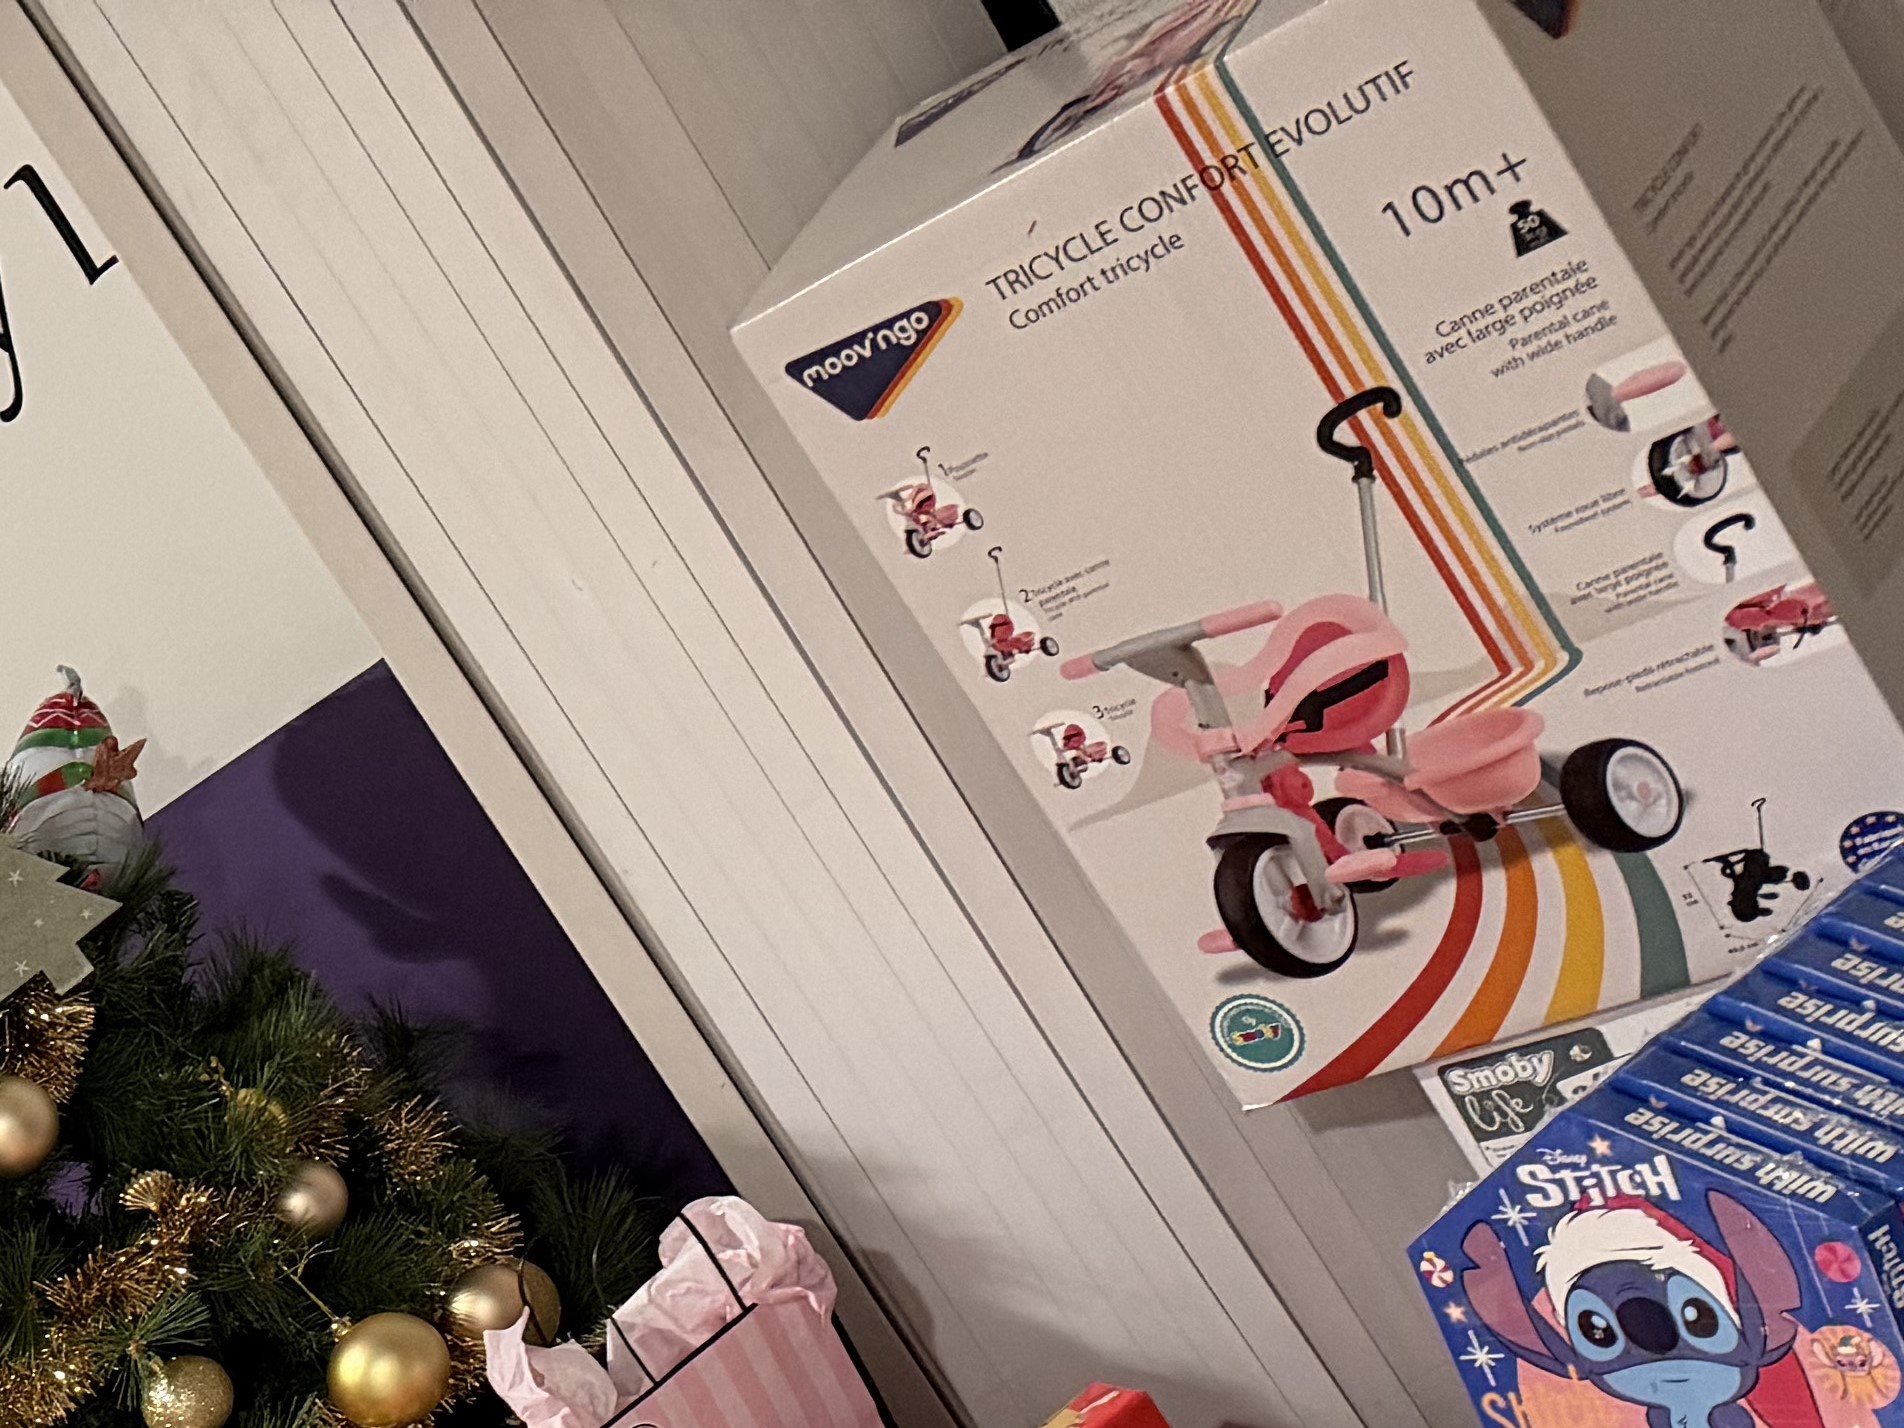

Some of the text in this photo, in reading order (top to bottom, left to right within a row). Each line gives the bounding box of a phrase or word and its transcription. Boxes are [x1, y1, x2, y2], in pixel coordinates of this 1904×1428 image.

[985, 59, 1416, 302] TRICYCLE CONFORT EVOLUTIF
[1008, 230, 1186, 330] Comfort tricycle
[1424, 274, 1599, 365] avec large poignée
[1435, 300, 1498, 338] Canne
[1508, 299, 1611, 351] Parental cane
[1491, 354, 1526, 379] with
[1526, 338, 1564, 362] wide
[1019, 588, 1033, 603] 2
[1092, 704, 1105, 721] 3
[1445, 1049, 1555, 1096] Smoby
[1719, 1030, 1861, 1093] surprise
[1464, 1089, 1534, 1133] life
[1624, 1107, 1840, 1204] with surprise
